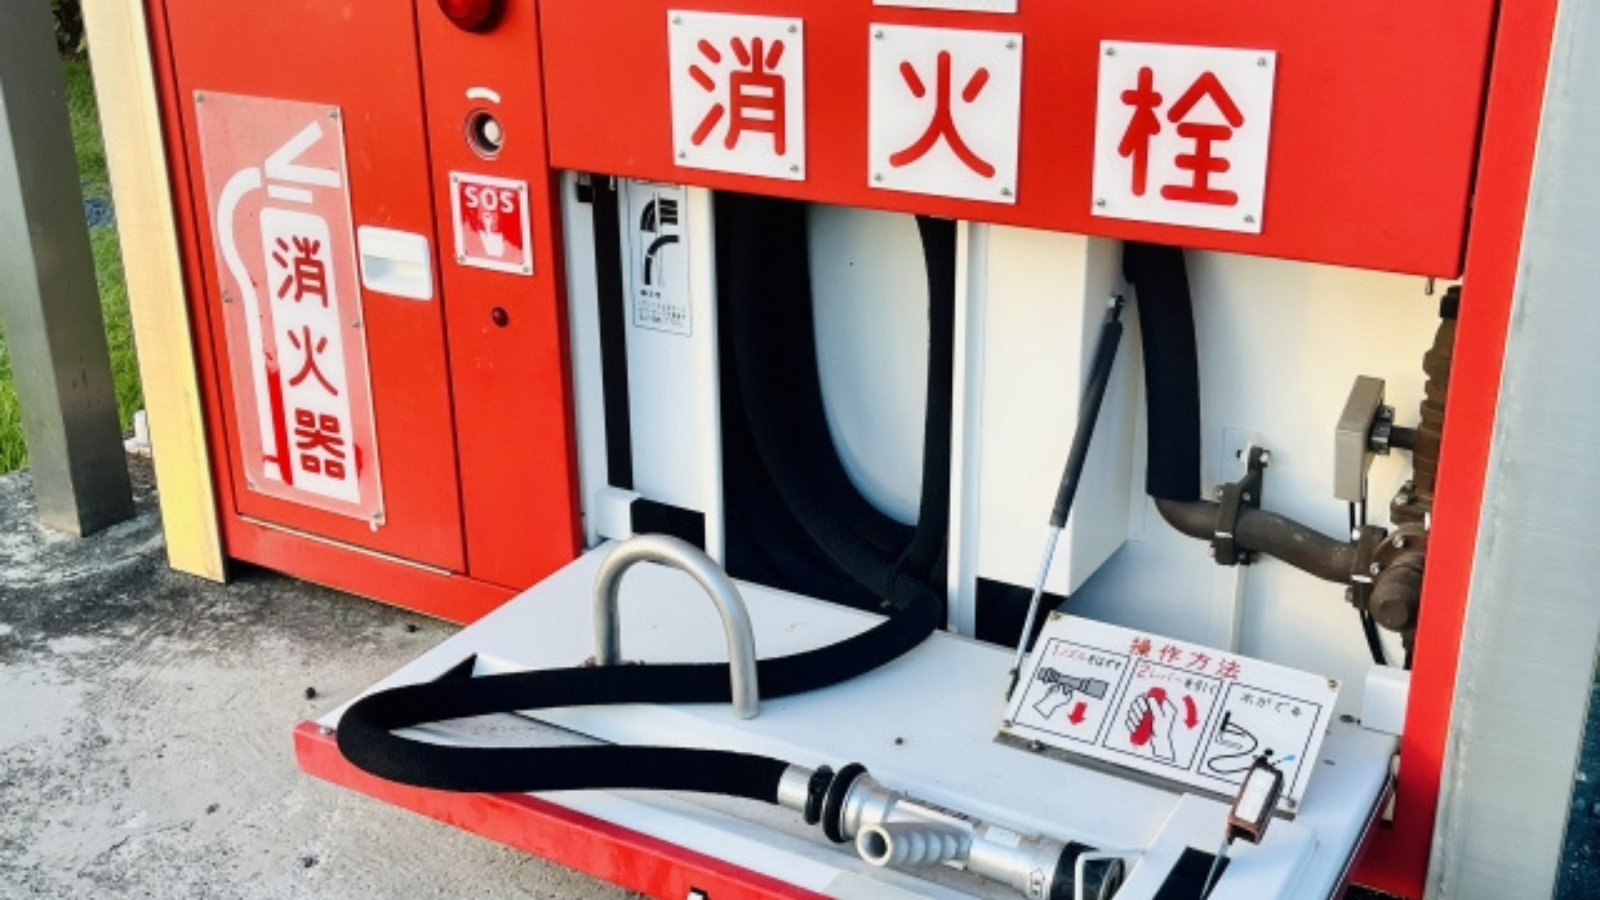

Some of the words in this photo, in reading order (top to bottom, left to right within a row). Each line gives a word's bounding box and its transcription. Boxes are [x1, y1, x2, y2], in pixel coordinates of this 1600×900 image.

[464, 186, 515, 213] SOS
[274, 236, 346, 481] 消火器
[1129, 637, 1241, 680] 操作方法
